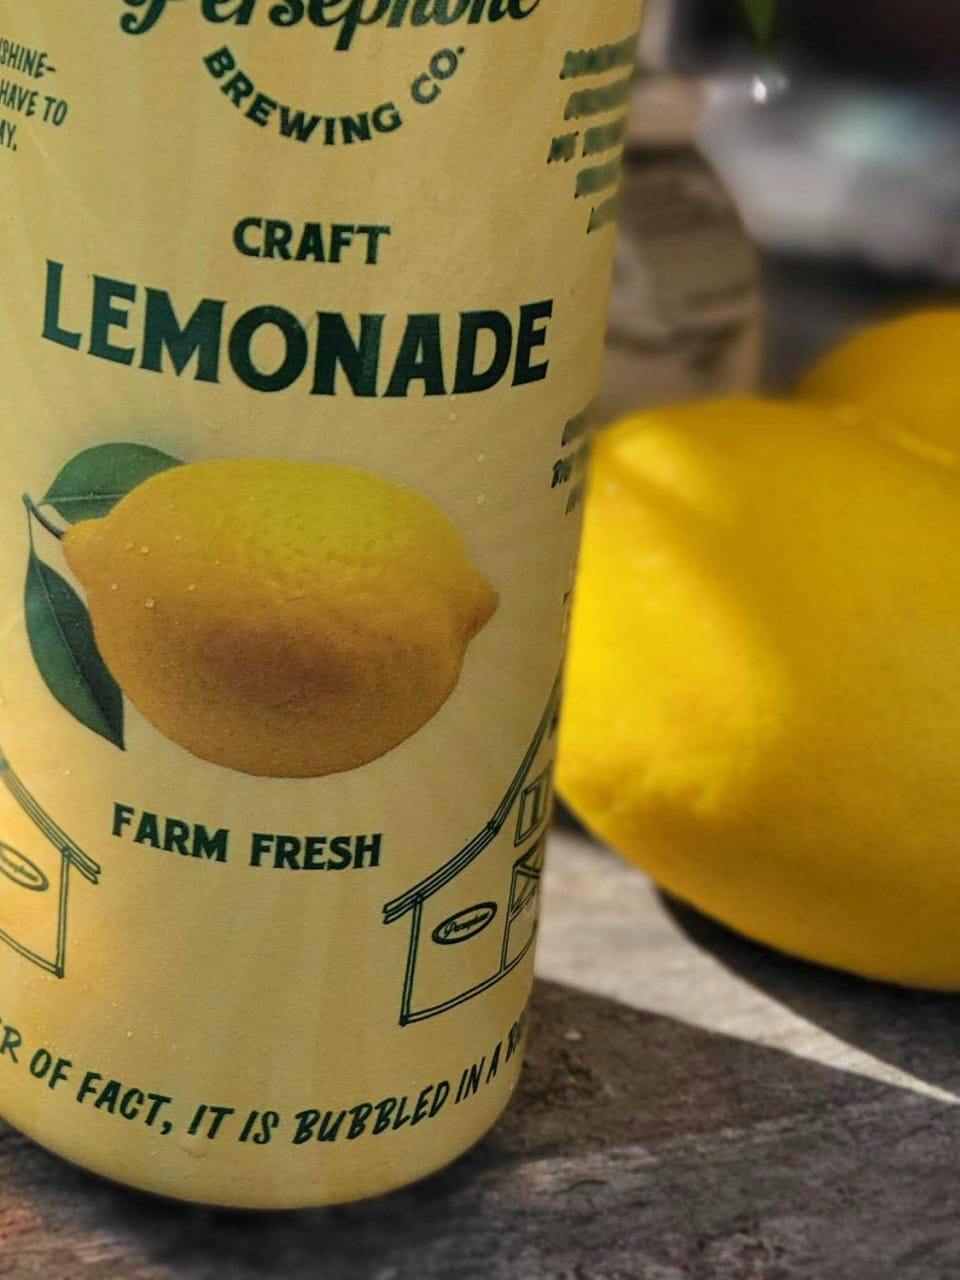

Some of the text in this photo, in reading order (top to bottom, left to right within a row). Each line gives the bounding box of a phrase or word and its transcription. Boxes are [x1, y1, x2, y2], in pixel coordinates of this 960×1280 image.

[43, 95, 68, 127] TO
[201, 45, 403, 147] BREWING
[410, 45, 465, 105] CO.
[233, 216, 391, 266] CRAFT
[41, 258, 555, 399] LEMONADE
[111, 802, 383, 873] FARM FRESH
[29, 1048, 72, 1090] OF
[76, 1071, 173, 1136] FACT,
[187, 1104, 235, 1140] IT
[238, 1110, 280, 1145] IS
[292, 1080, 450, 1145] BUBBLED
[454, 1056, 486, 1105] IN
